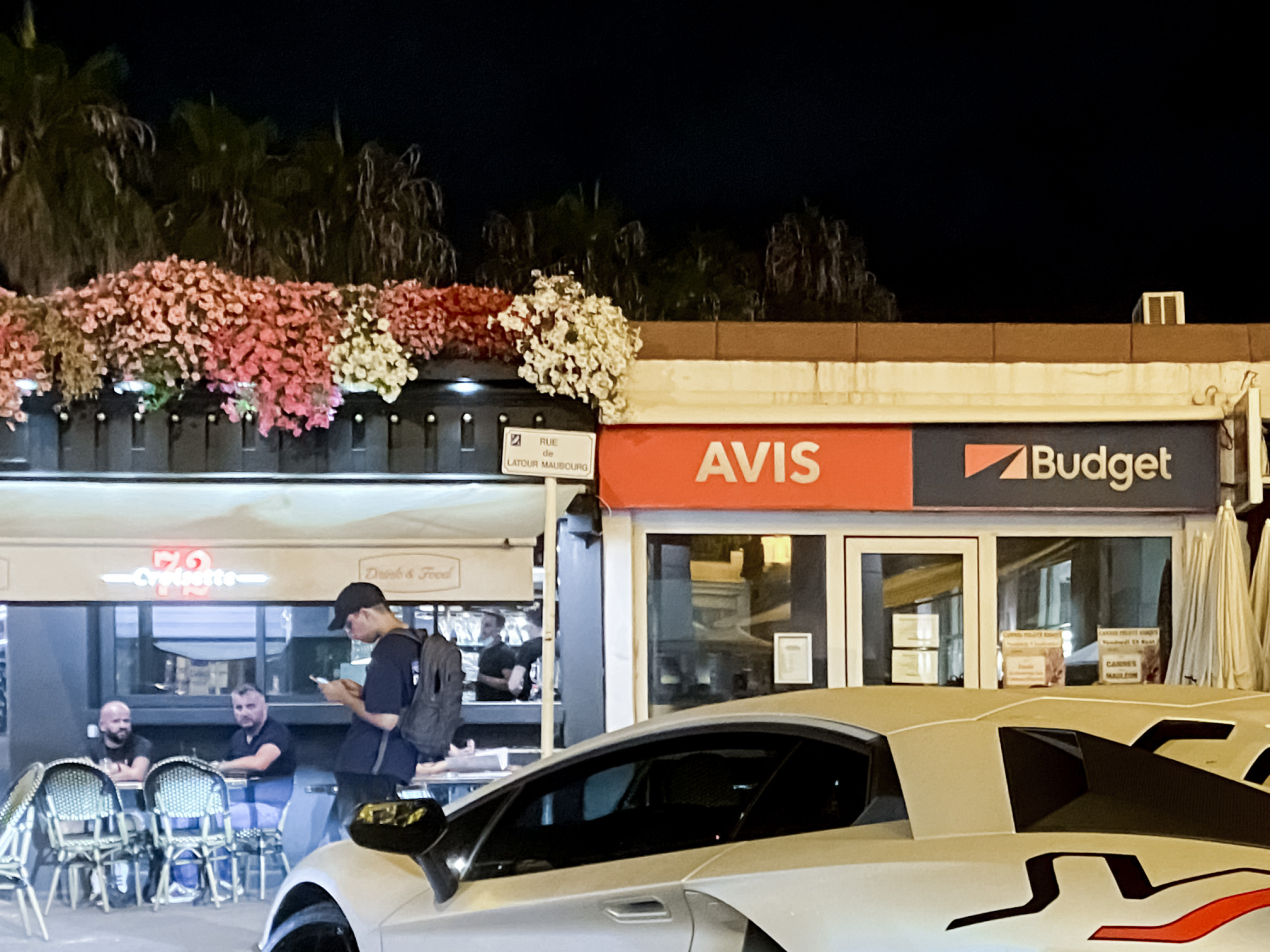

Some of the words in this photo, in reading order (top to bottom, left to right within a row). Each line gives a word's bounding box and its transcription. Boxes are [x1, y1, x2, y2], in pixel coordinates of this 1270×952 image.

[539, 437, 558, 447] RUE
[542, 448, 553, 457] de
[507, 458, 538, 468] LATOUR
[541, 461, 588, 472] MAUBOURG
[695, 440, 820, 484] AVIS
[1031, 444, 1172, 492] Budget
[152, 549, 212, 597] 72
[405, 567, 414, 579] &
[418, 565, 455, 580] Food
